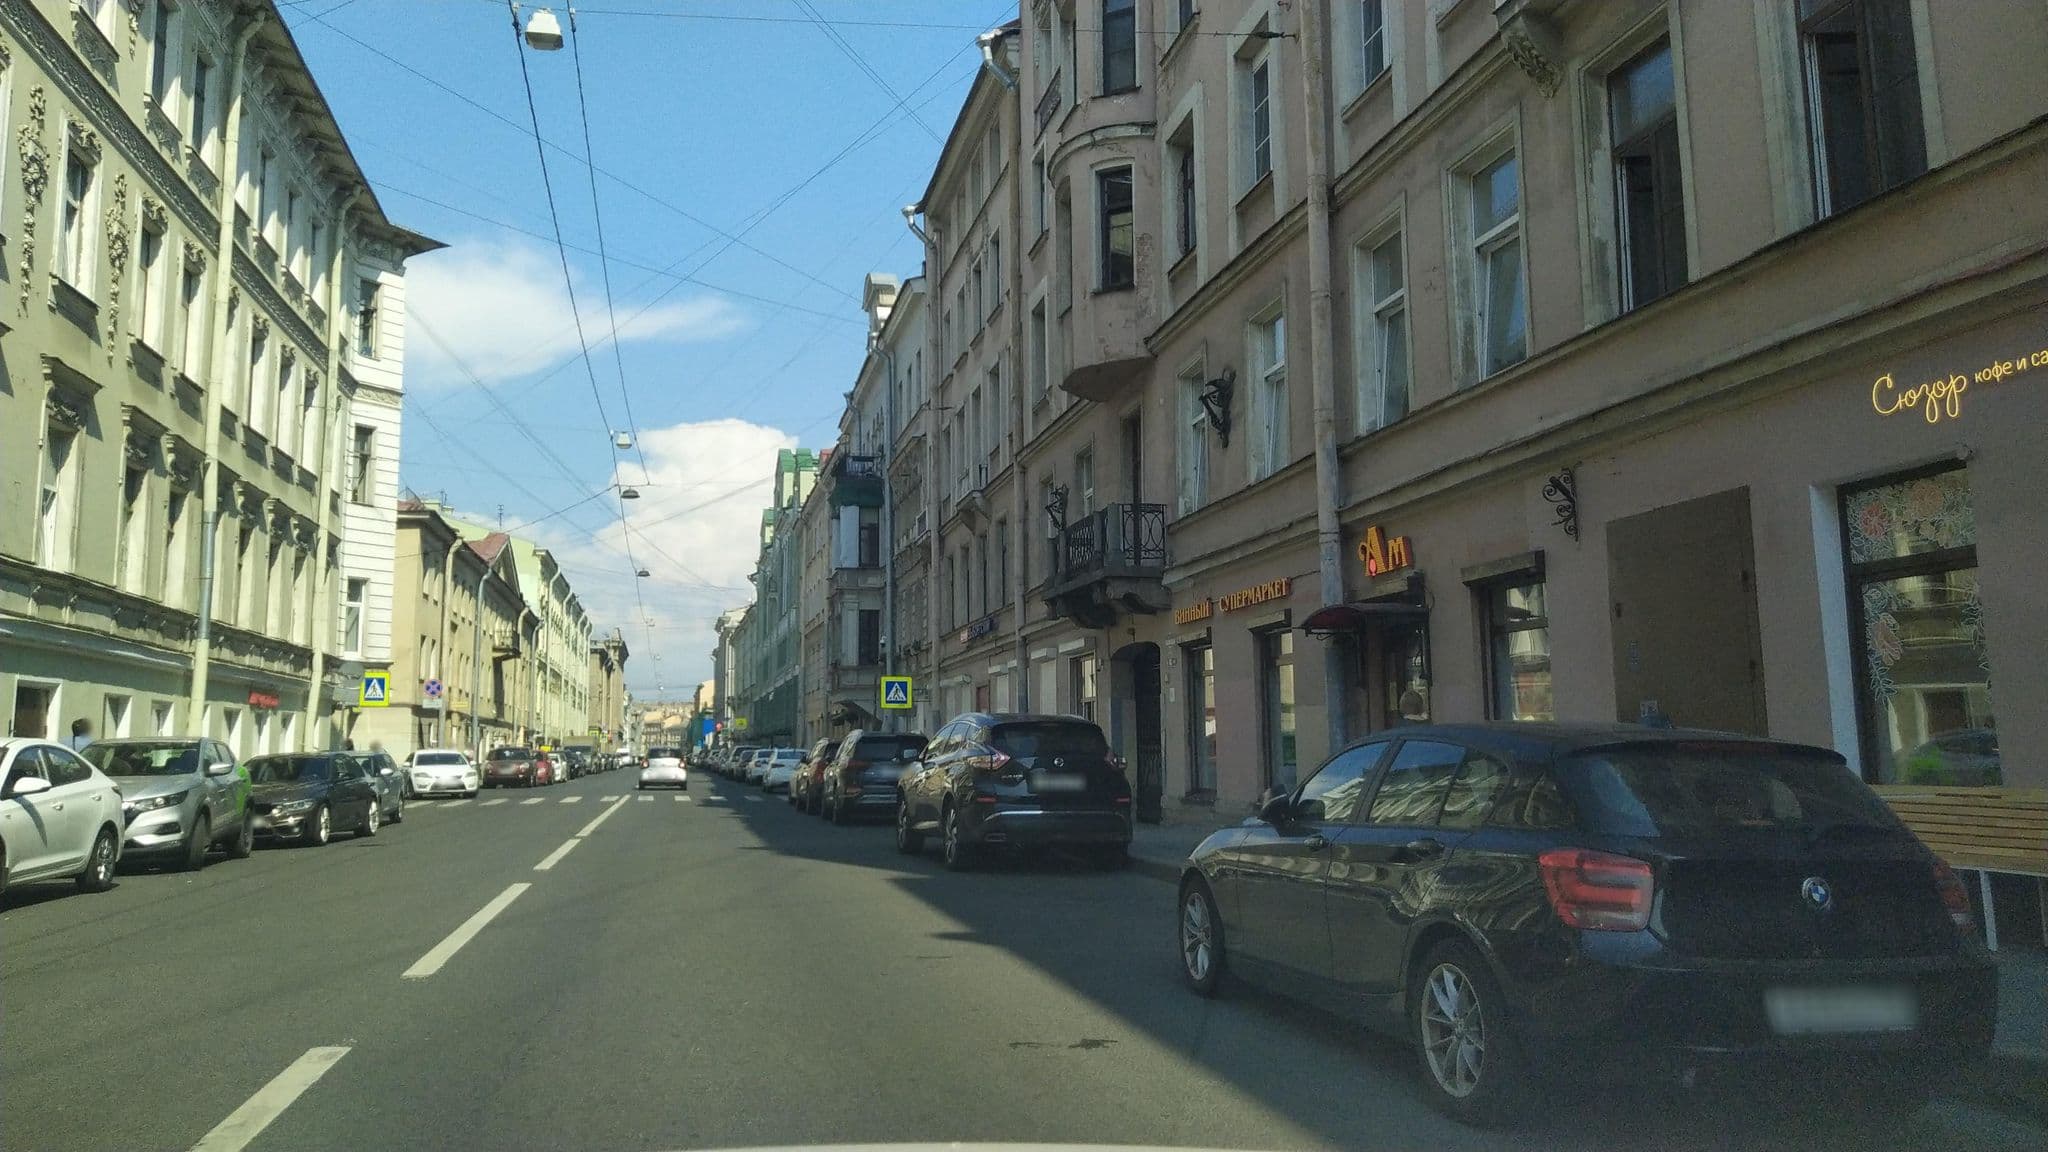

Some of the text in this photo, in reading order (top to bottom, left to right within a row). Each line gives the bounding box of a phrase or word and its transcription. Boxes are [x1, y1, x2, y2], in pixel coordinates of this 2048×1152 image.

[1872, 373, 1967, 423] Сюзор
[1974, 360, 2013, 383] кофе
[2016, 357, 2027, 370] и
[1219, 577, 1290, 612] СУПЕРМАРКЕТ
